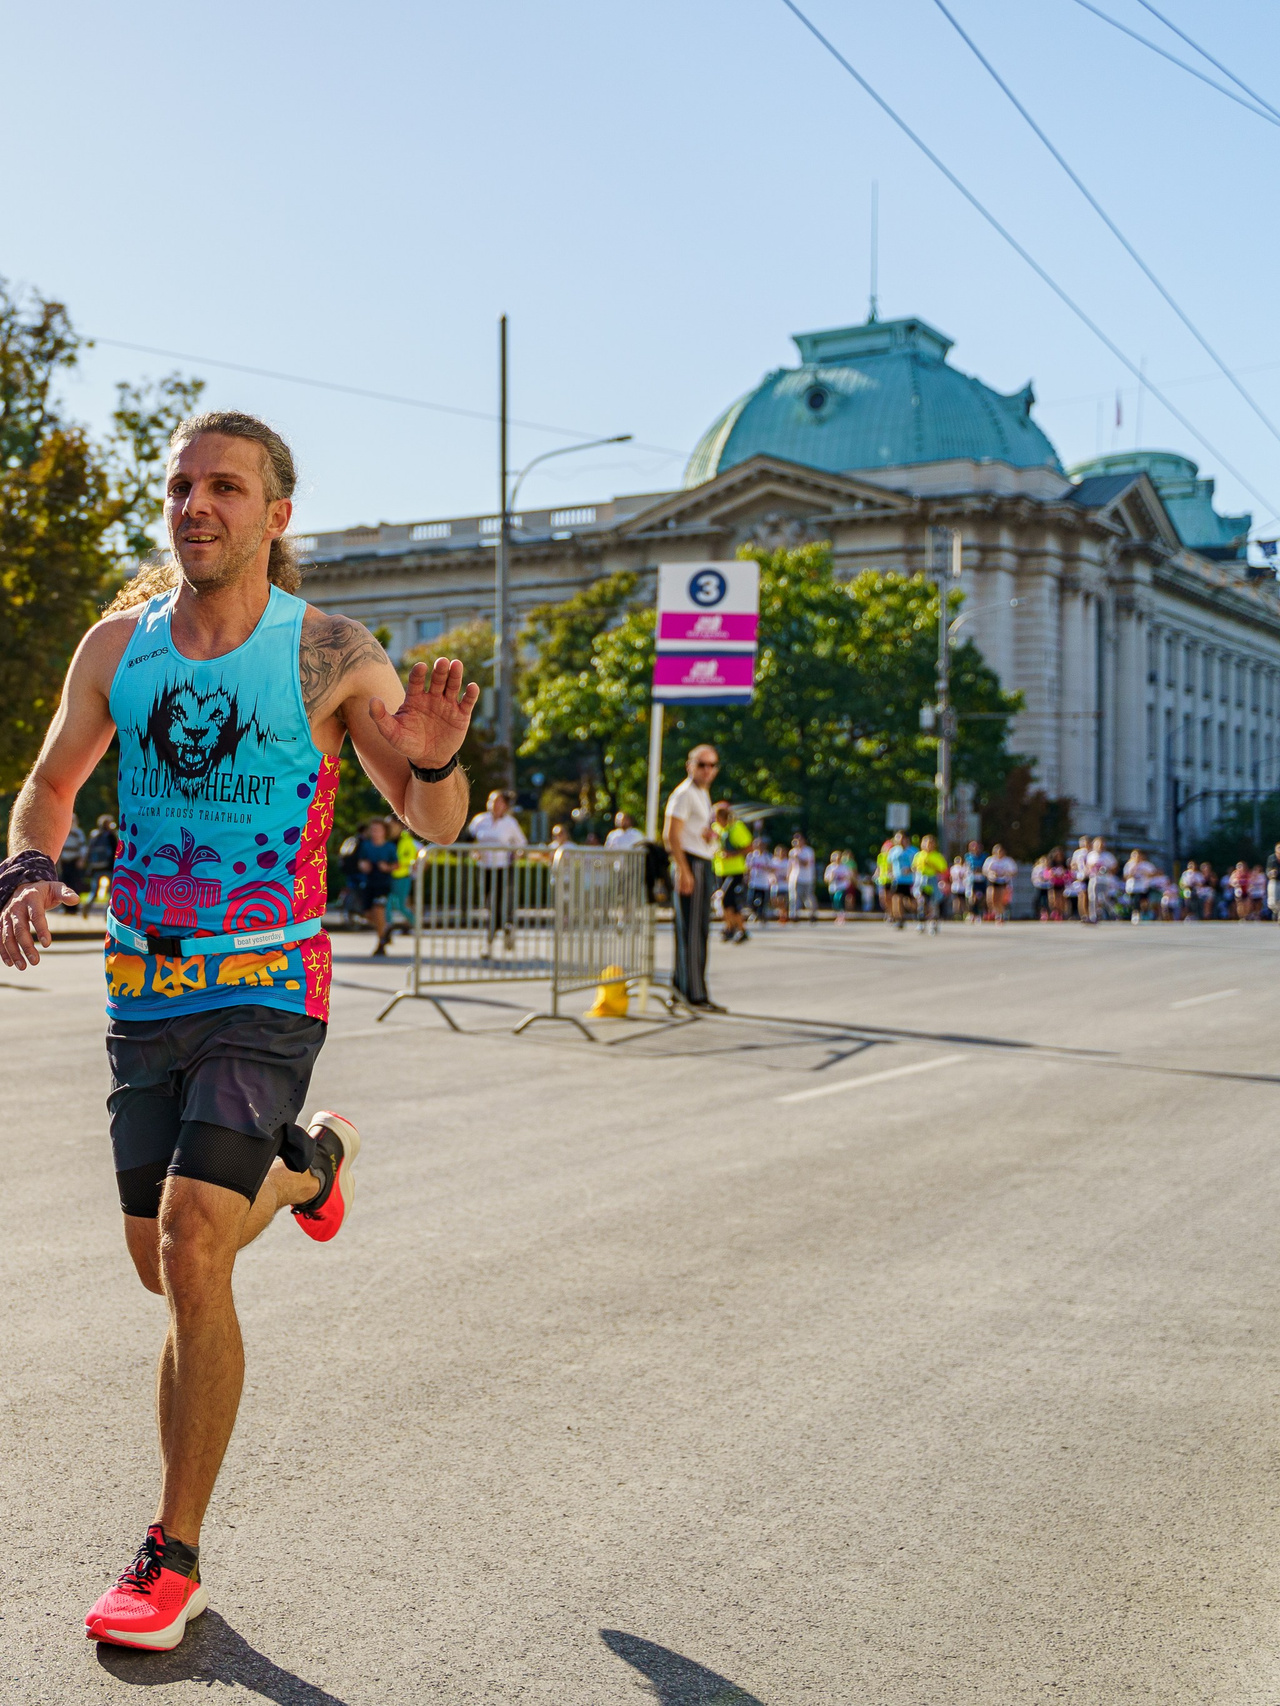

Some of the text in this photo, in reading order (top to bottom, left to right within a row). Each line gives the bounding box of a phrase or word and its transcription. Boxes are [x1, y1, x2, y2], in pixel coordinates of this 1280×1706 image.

[696, 574, 721, 604] 3
[135, 646, 169, 664] BRYZOS
[205, 771, 275, 806] HEART
[138, 806, 252, 824] ULTRA CROSS TRIATHLON
